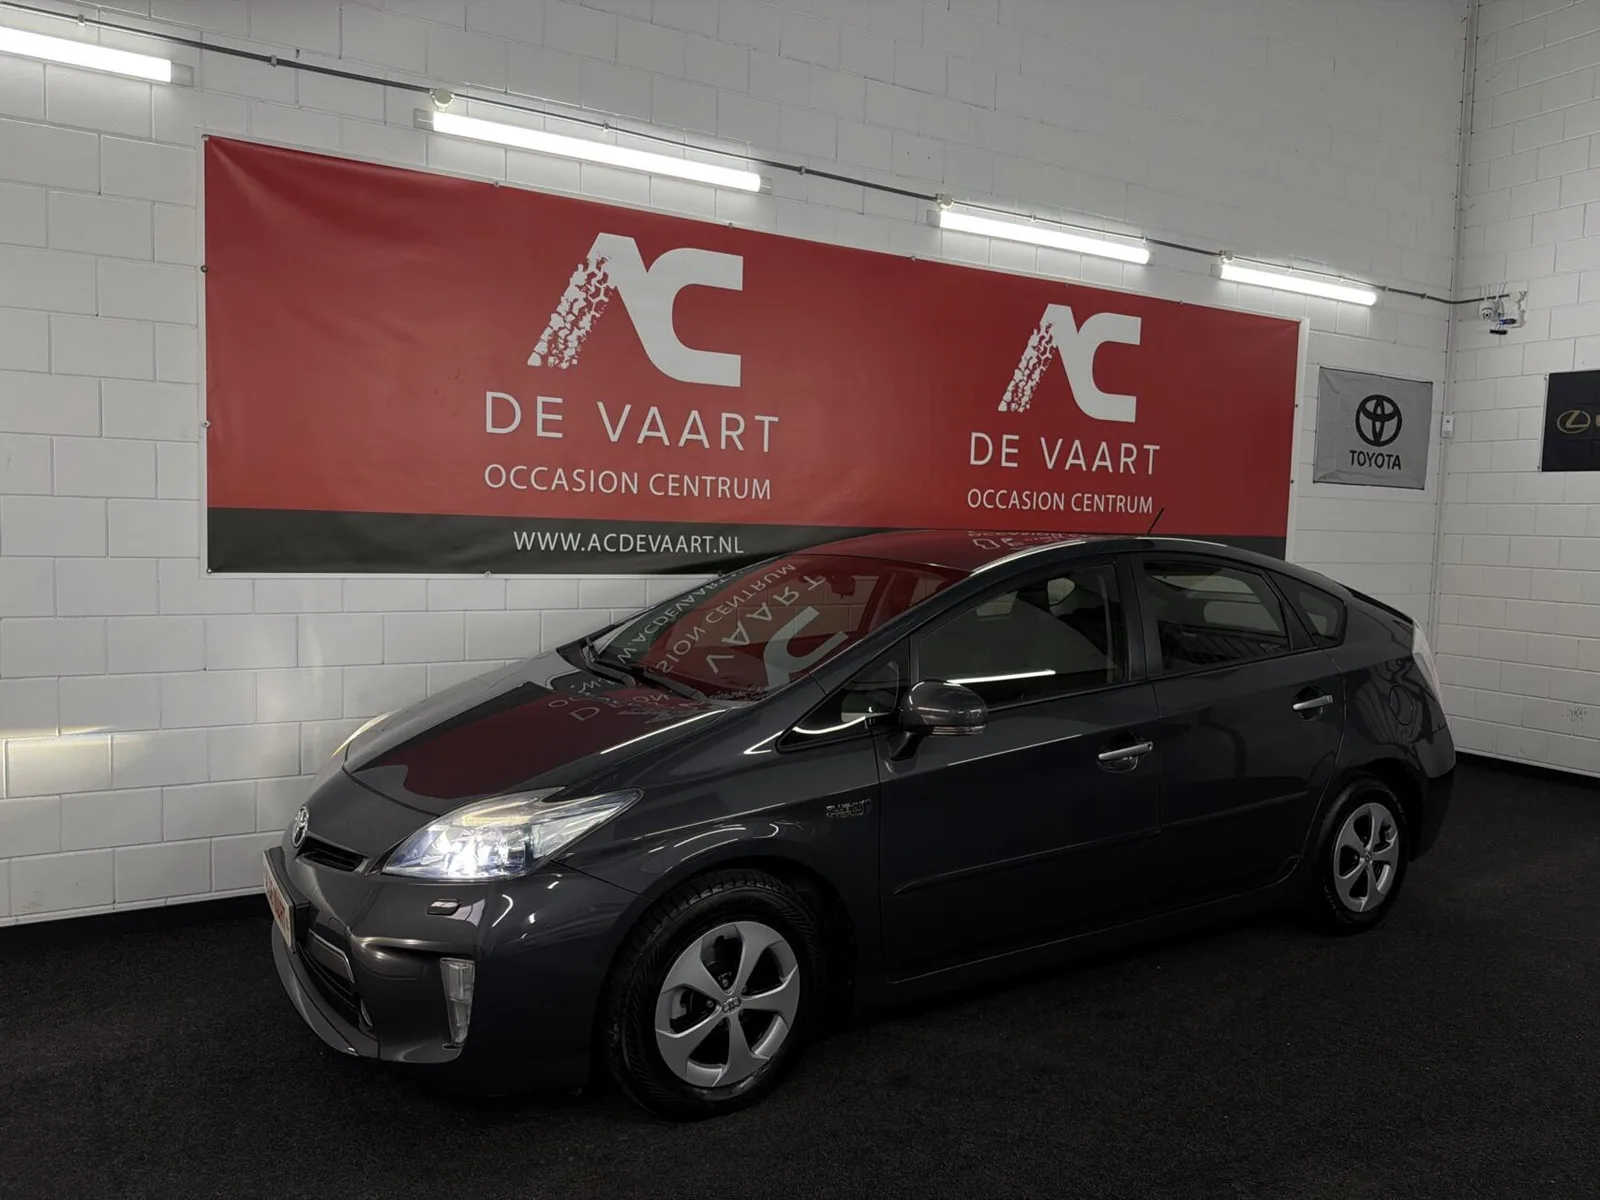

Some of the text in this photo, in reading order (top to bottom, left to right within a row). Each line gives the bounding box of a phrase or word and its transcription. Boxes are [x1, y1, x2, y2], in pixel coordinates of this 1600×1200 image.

[527, 232, 744, 388] AC
[998, 303, 1142, 423] AC
[485, 390, 780, 453] DE VAART
[969, 431, 1161, 475] DE VAART
[1349, 449, 1402, 471] TOYOTA
[484, 463, 771, 500] OCCASION CENTRUM
[967, 488, 1153, 514] OCCASION CENTRUM
[513, 531, 745, 555] WWW.ACDEVAART.NL
